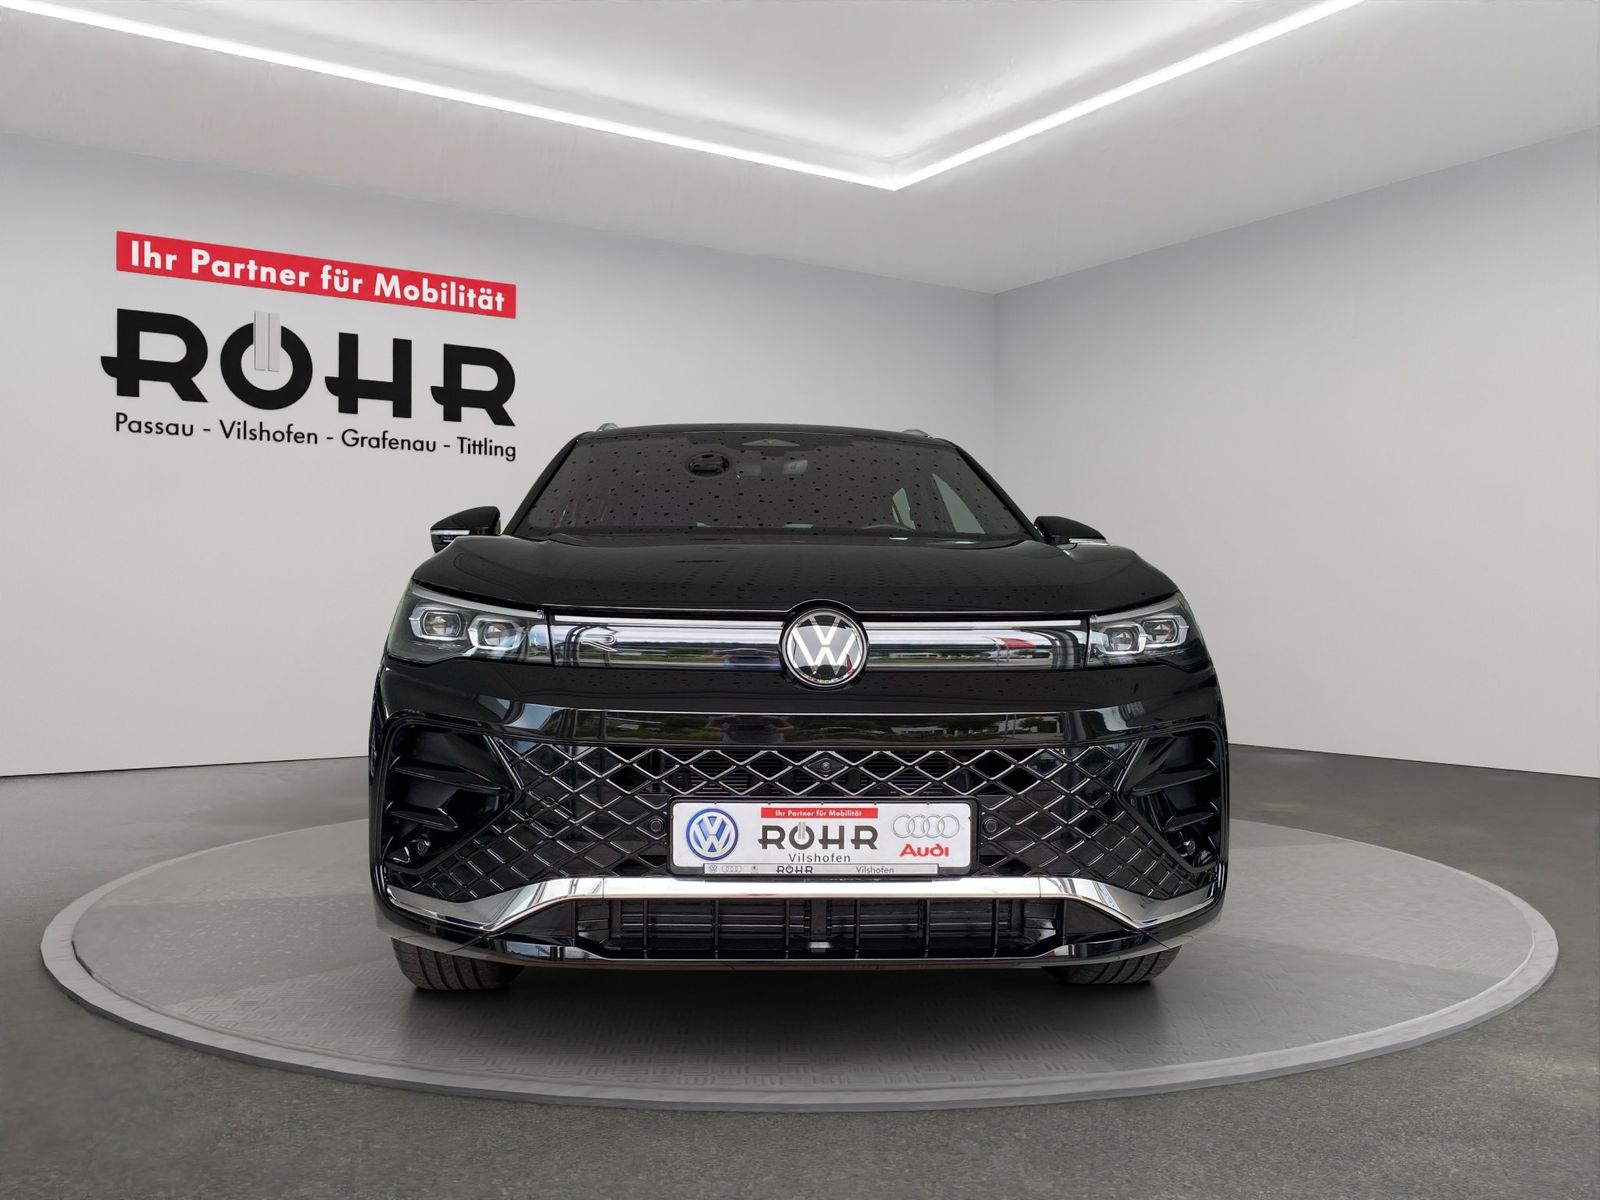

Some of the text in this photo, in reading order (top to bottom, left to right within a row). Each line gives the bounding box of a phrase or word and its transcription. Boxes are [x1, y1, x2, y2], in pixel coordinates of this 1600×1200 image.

[131, 240, 505, 312] Ihr Partner für Mobilität
[115, 412, 194, 437] Passau
[219, 420, 319, 446] Vilshofen
[341, 429, 437, 453] Grafenau
[457, 437, 516, 462] Tittling
[816, 809, 827, 817] für
[900, 843, 949, 857] Audi
[789, 853, 851, 863] Vilshofen
[856, 866, 895, 874] Vilshofen
